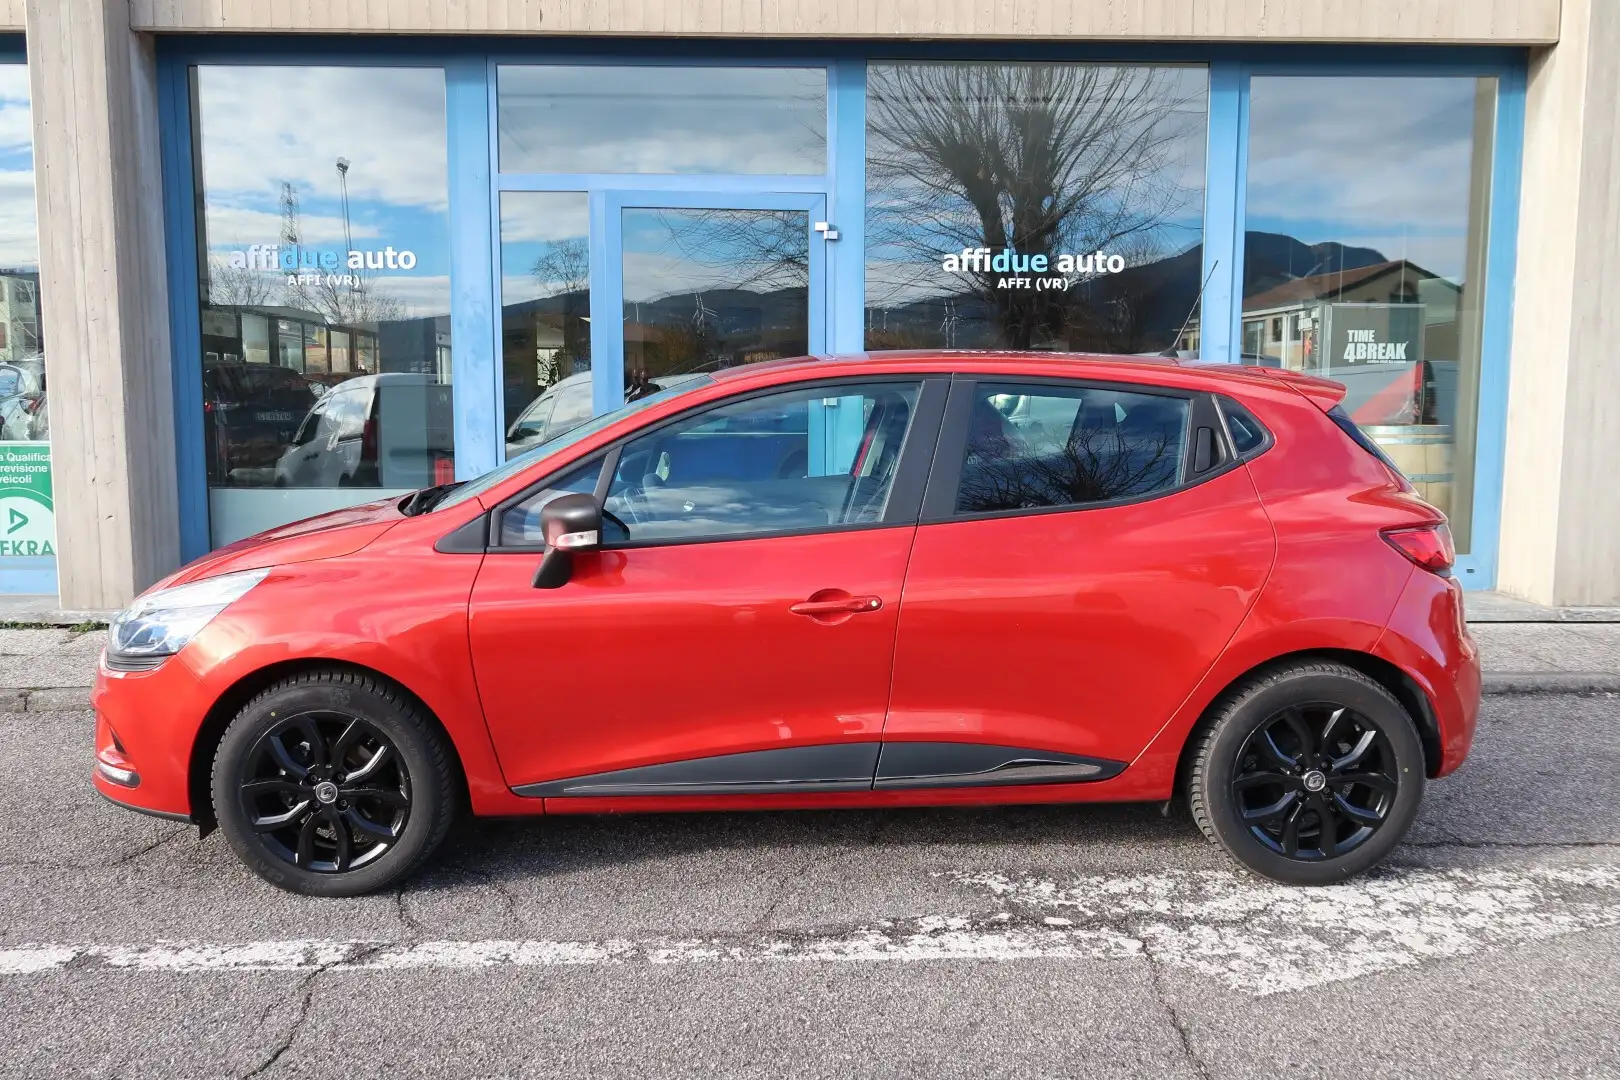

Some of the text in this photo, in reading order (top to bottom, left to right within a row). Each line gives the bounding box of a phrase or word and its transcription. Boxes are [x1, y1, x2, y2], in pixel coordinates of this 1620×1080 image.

[229, 244, 417, 270] affidue auto
[942, 247, 1125, 273] affidue auto
[287, 274, 360, 288] AFFI (VR)
[997, 277, 1069, 292] AFFI (VR)
[1347, 329, 1376, 342] TIME
[1343, 342, 1407, 363] 4BREAK
